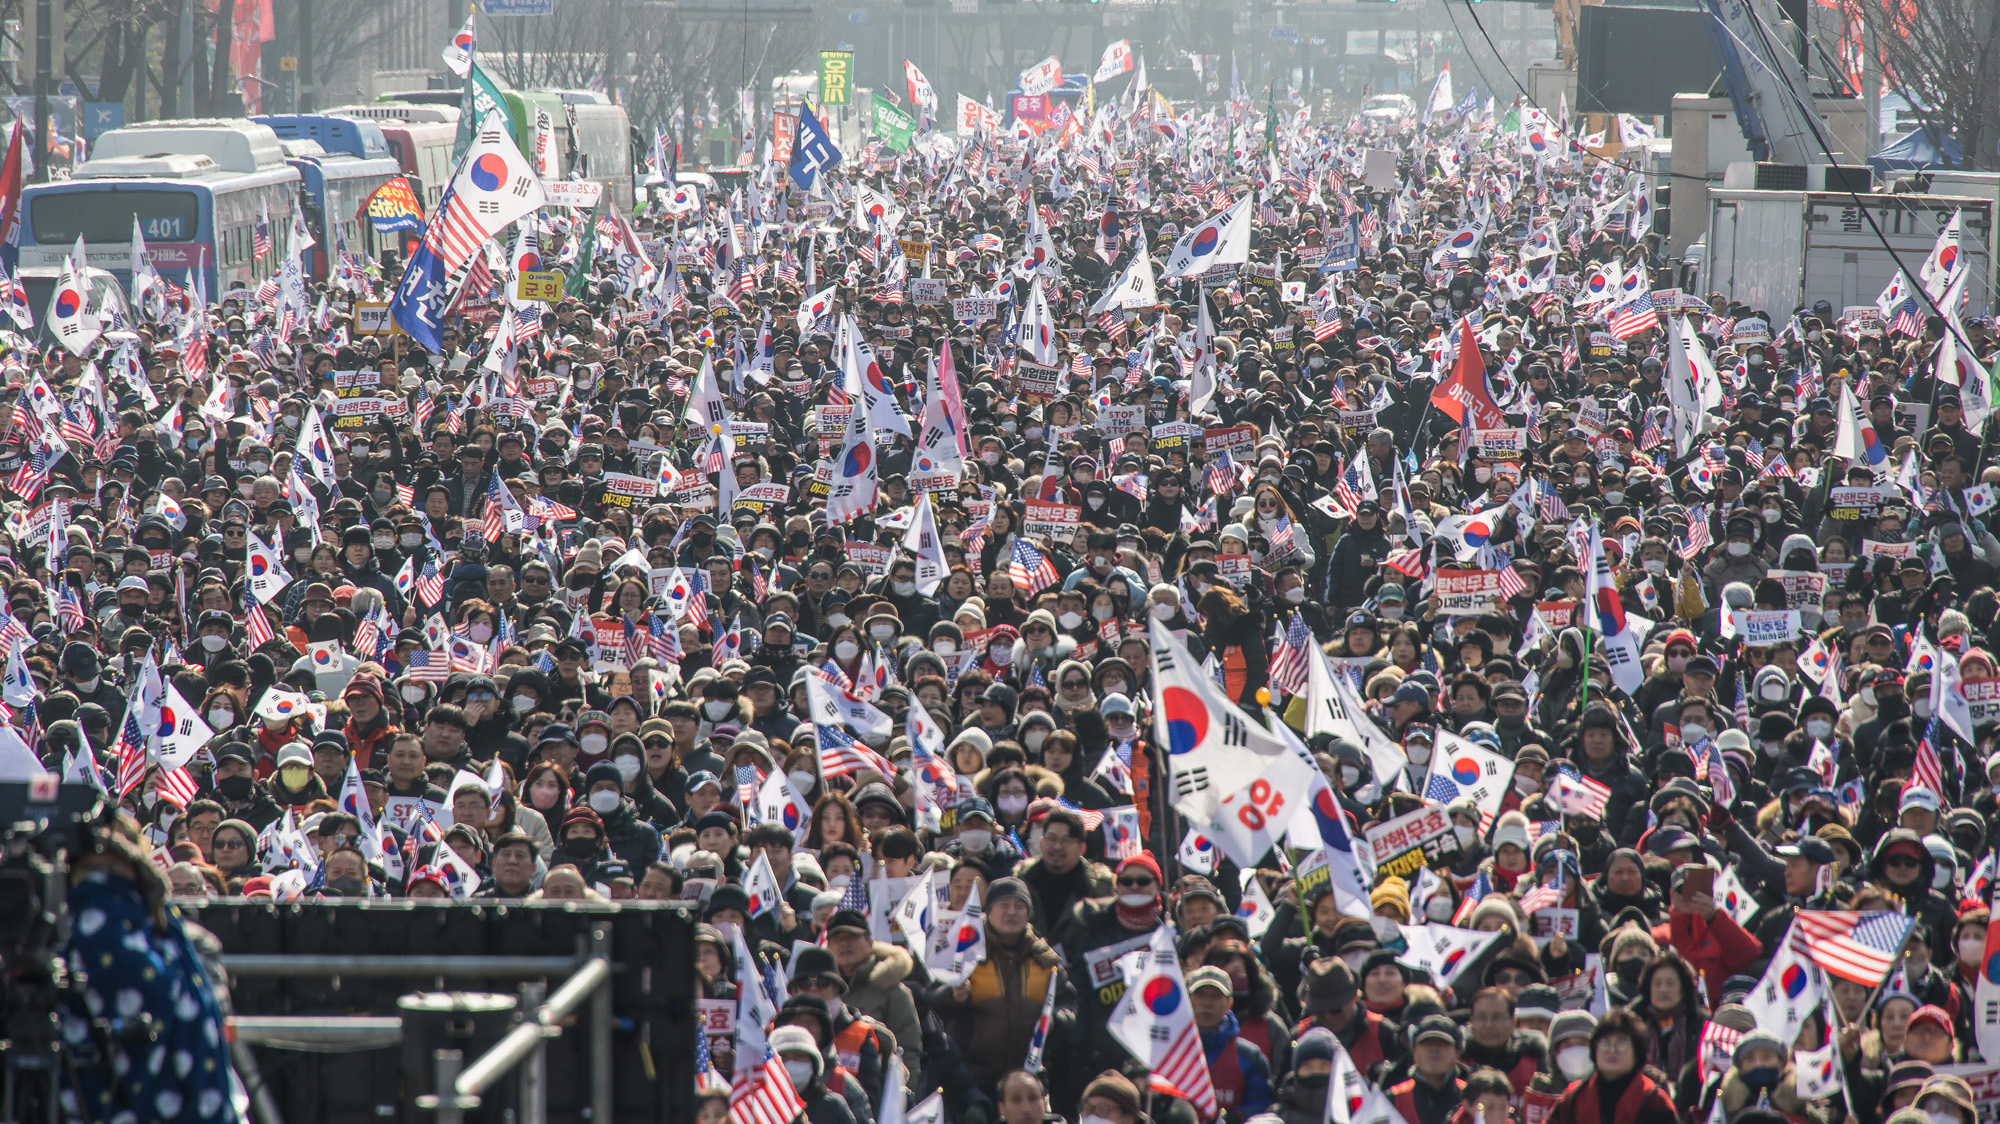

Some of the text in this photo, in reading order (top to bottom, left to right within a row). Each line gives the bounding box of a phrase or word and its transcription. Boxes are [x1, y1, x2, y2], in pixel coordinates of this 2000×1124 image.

[148, 219, 182, 238] 401
[149, 248, 188, 262] 가패스
[917, 281, 937, 289] STOP
[914, 294, 938, 302] STEAL
[956, 300, 995, 317] 청주3호차
[337, 373, 379, 387] 탄핵무효
[337, 400, 382, 415] 탄핵무효
[1108, 411, 1135, 419] STOP
[1112, 418, 1132, 427] THE
[1154, 436, 1183, 451] 이재명
[1206, 429, 1253, 451] 탄핵무효
[1484, 440, 1517, 451] 민주당
[606, 479, 655, 496] 탄핵무효
[602, 491, 632, 508] 이재명
[939, 492, 958, 504] 구속
[1832, 491, 1881, 507] 탄핵무효
[1025, 505, 1080, 523] 탄핵무효
[1053, 525, 1076, 538] 구속
[1436, 573, 1499, 594] 탄핵무효
[1782, 577, 1822, 591] 법구속
[1786, 591, 1822, 608] 핵무효
[1747, 621, 1788, 634] 민주당
[392, 802, 437, 818] STP
[1371, 809, 1447, 863] 탄핵무효
[1378, 832, 1459, 878] 이재명 구속
